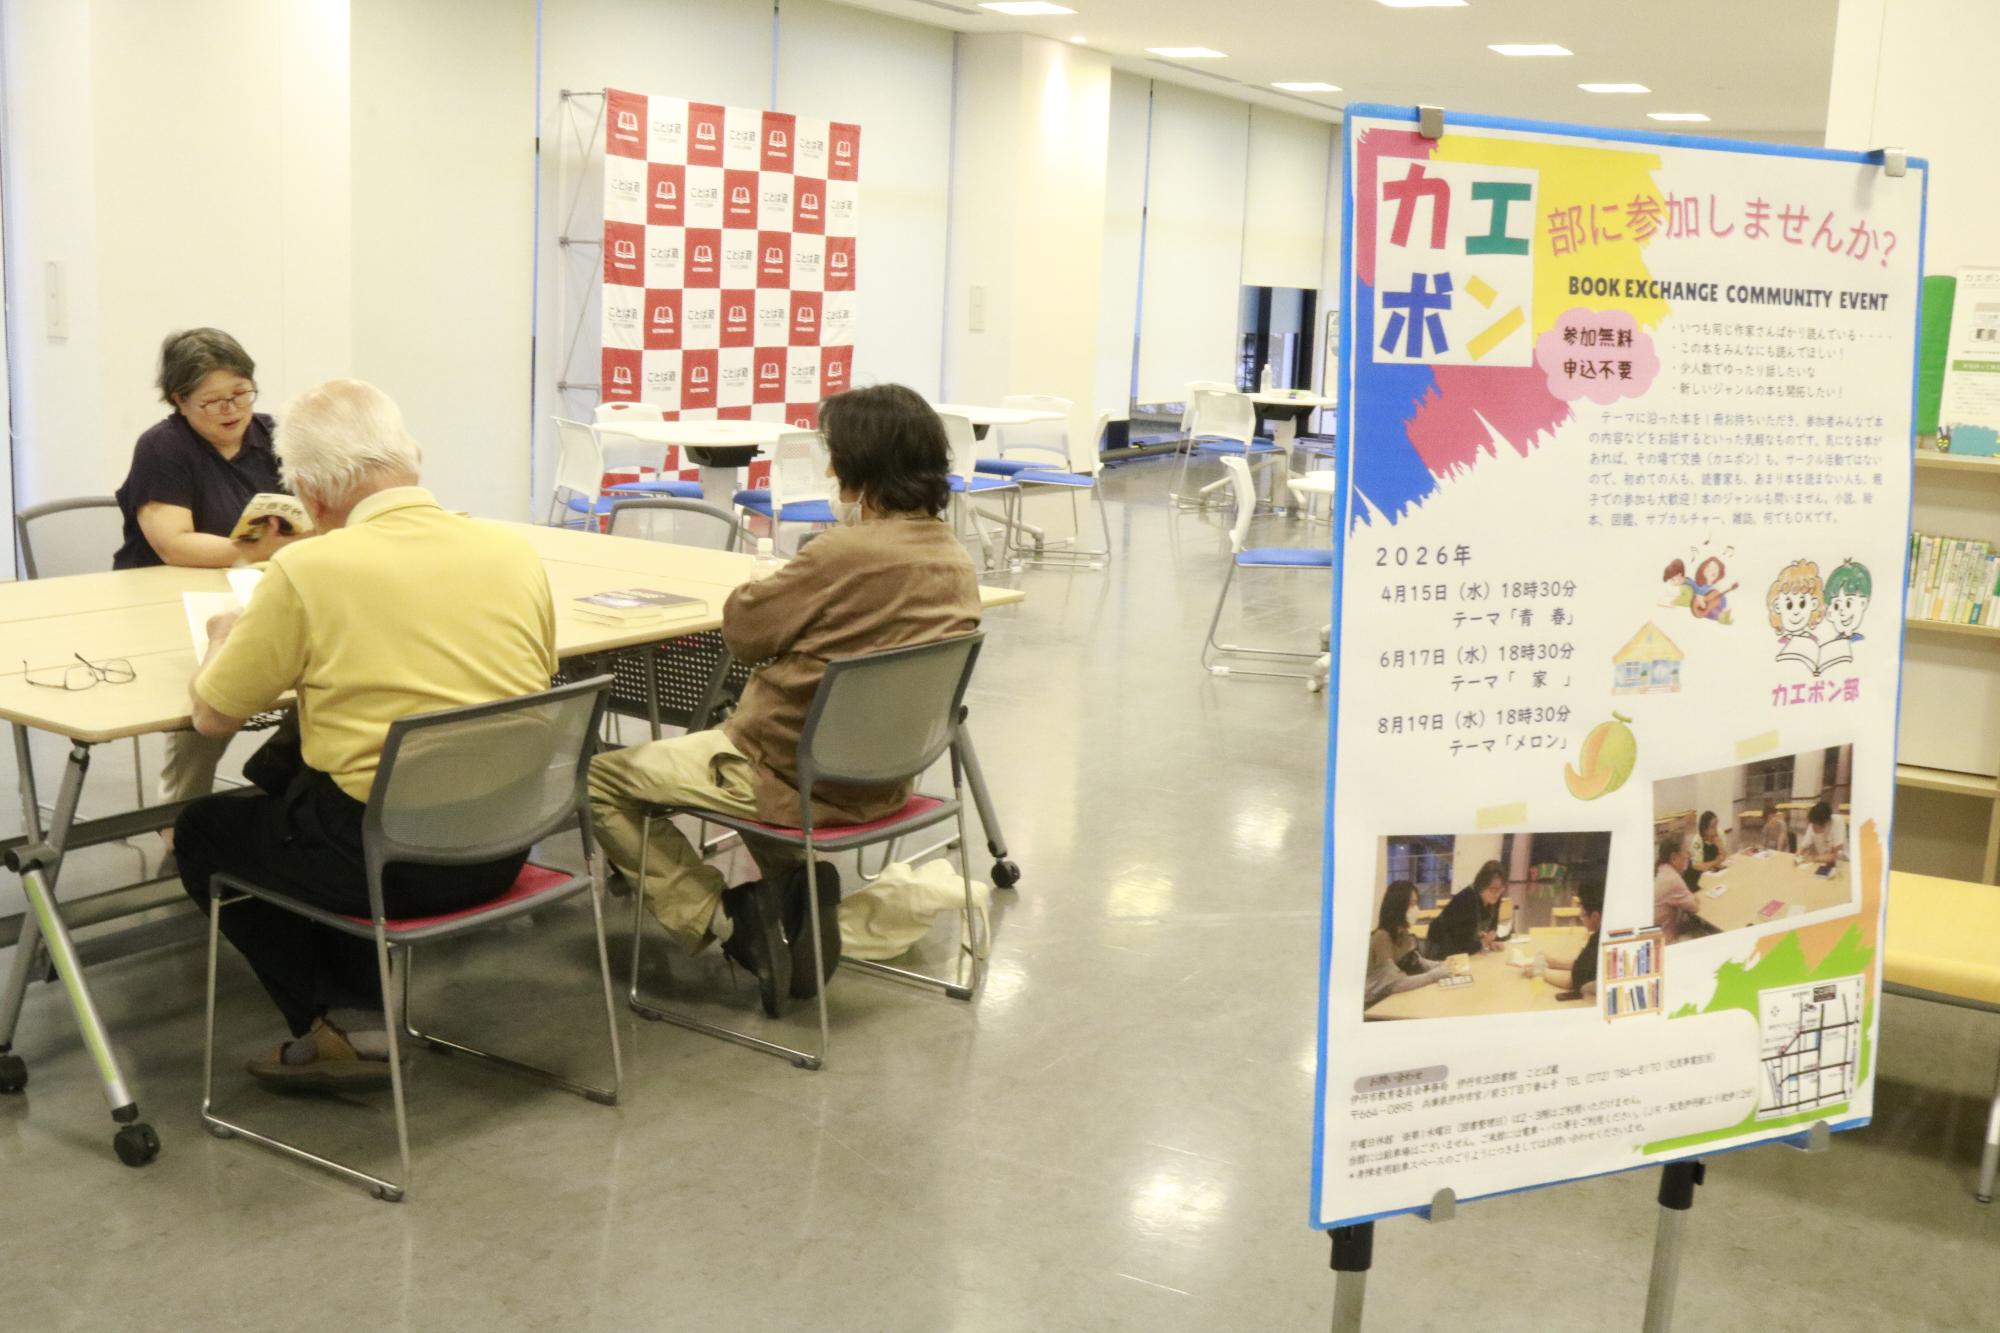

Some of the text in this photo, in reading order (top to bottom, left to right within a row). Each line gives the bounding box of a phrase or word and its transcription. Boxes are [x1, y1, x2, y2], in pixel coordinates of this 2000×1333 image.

[1383, 163, 1532, 256] カエ
[1547, 191, 1897, 268] 部に参加しませんか?
[1569, 276, 1889, 311] BOOK EXCHANGE COMMUNITY EVENT
[1563, 327, 1634, 348] 参加無料
[1563, 358, 1634, 380] 申込不要
[1376, 544, 1472, 567] 2026年
[1772, 678, 1859, 706] カエボン部
[1448, 734, 1569, 757] テーマ「メロン」
